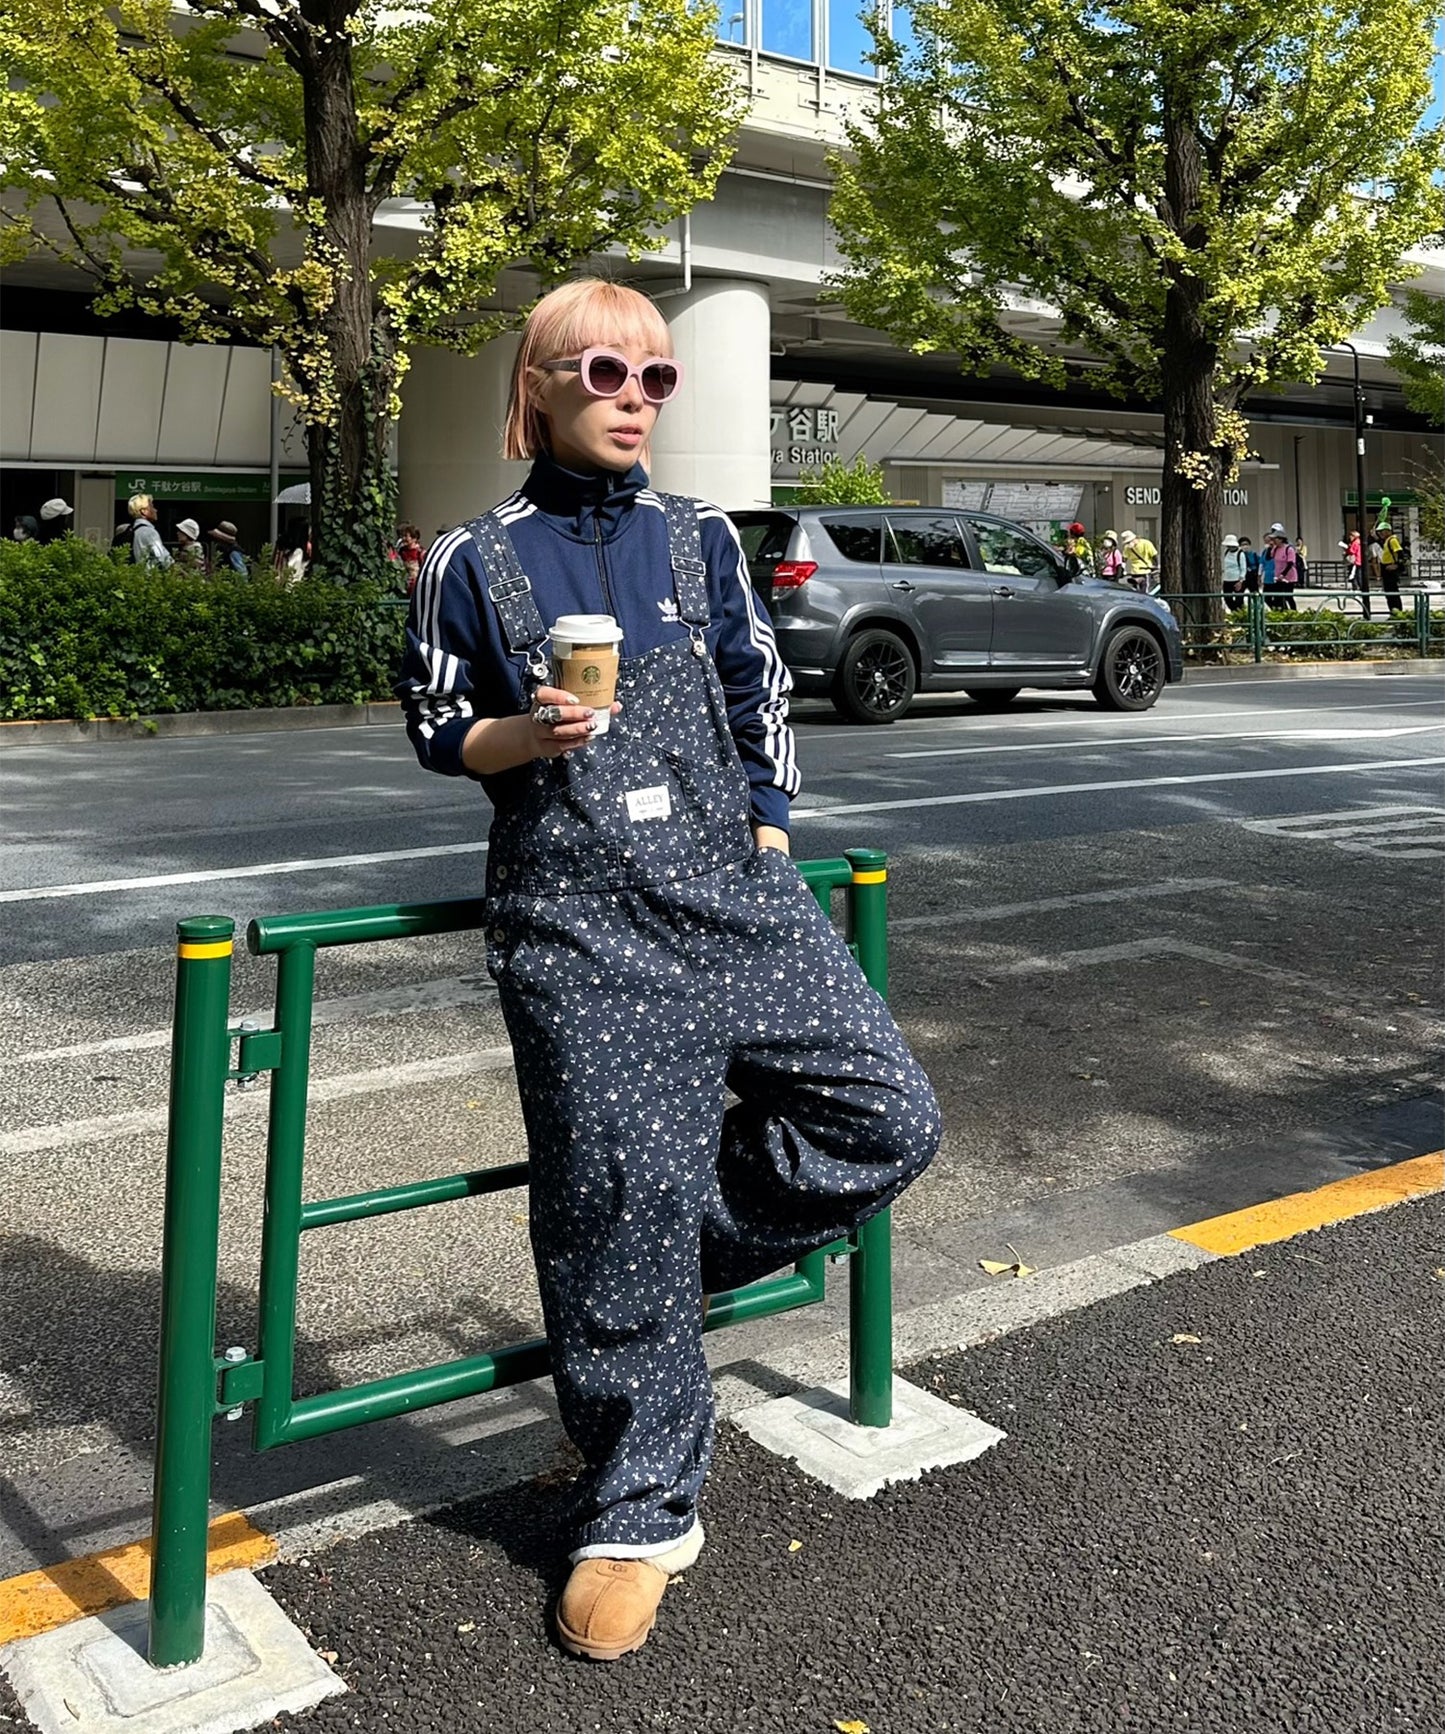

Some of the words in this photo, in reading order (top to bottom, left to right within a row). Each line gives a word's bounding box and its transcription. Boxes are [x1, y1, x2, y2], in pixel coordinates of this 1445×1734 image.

[128, 478, 146, 490] JR
[1127, 487, 1162, 505] SEND
[1223, 489, 1248, 505] TION
[635, 793, 664, 807] ALLEY
